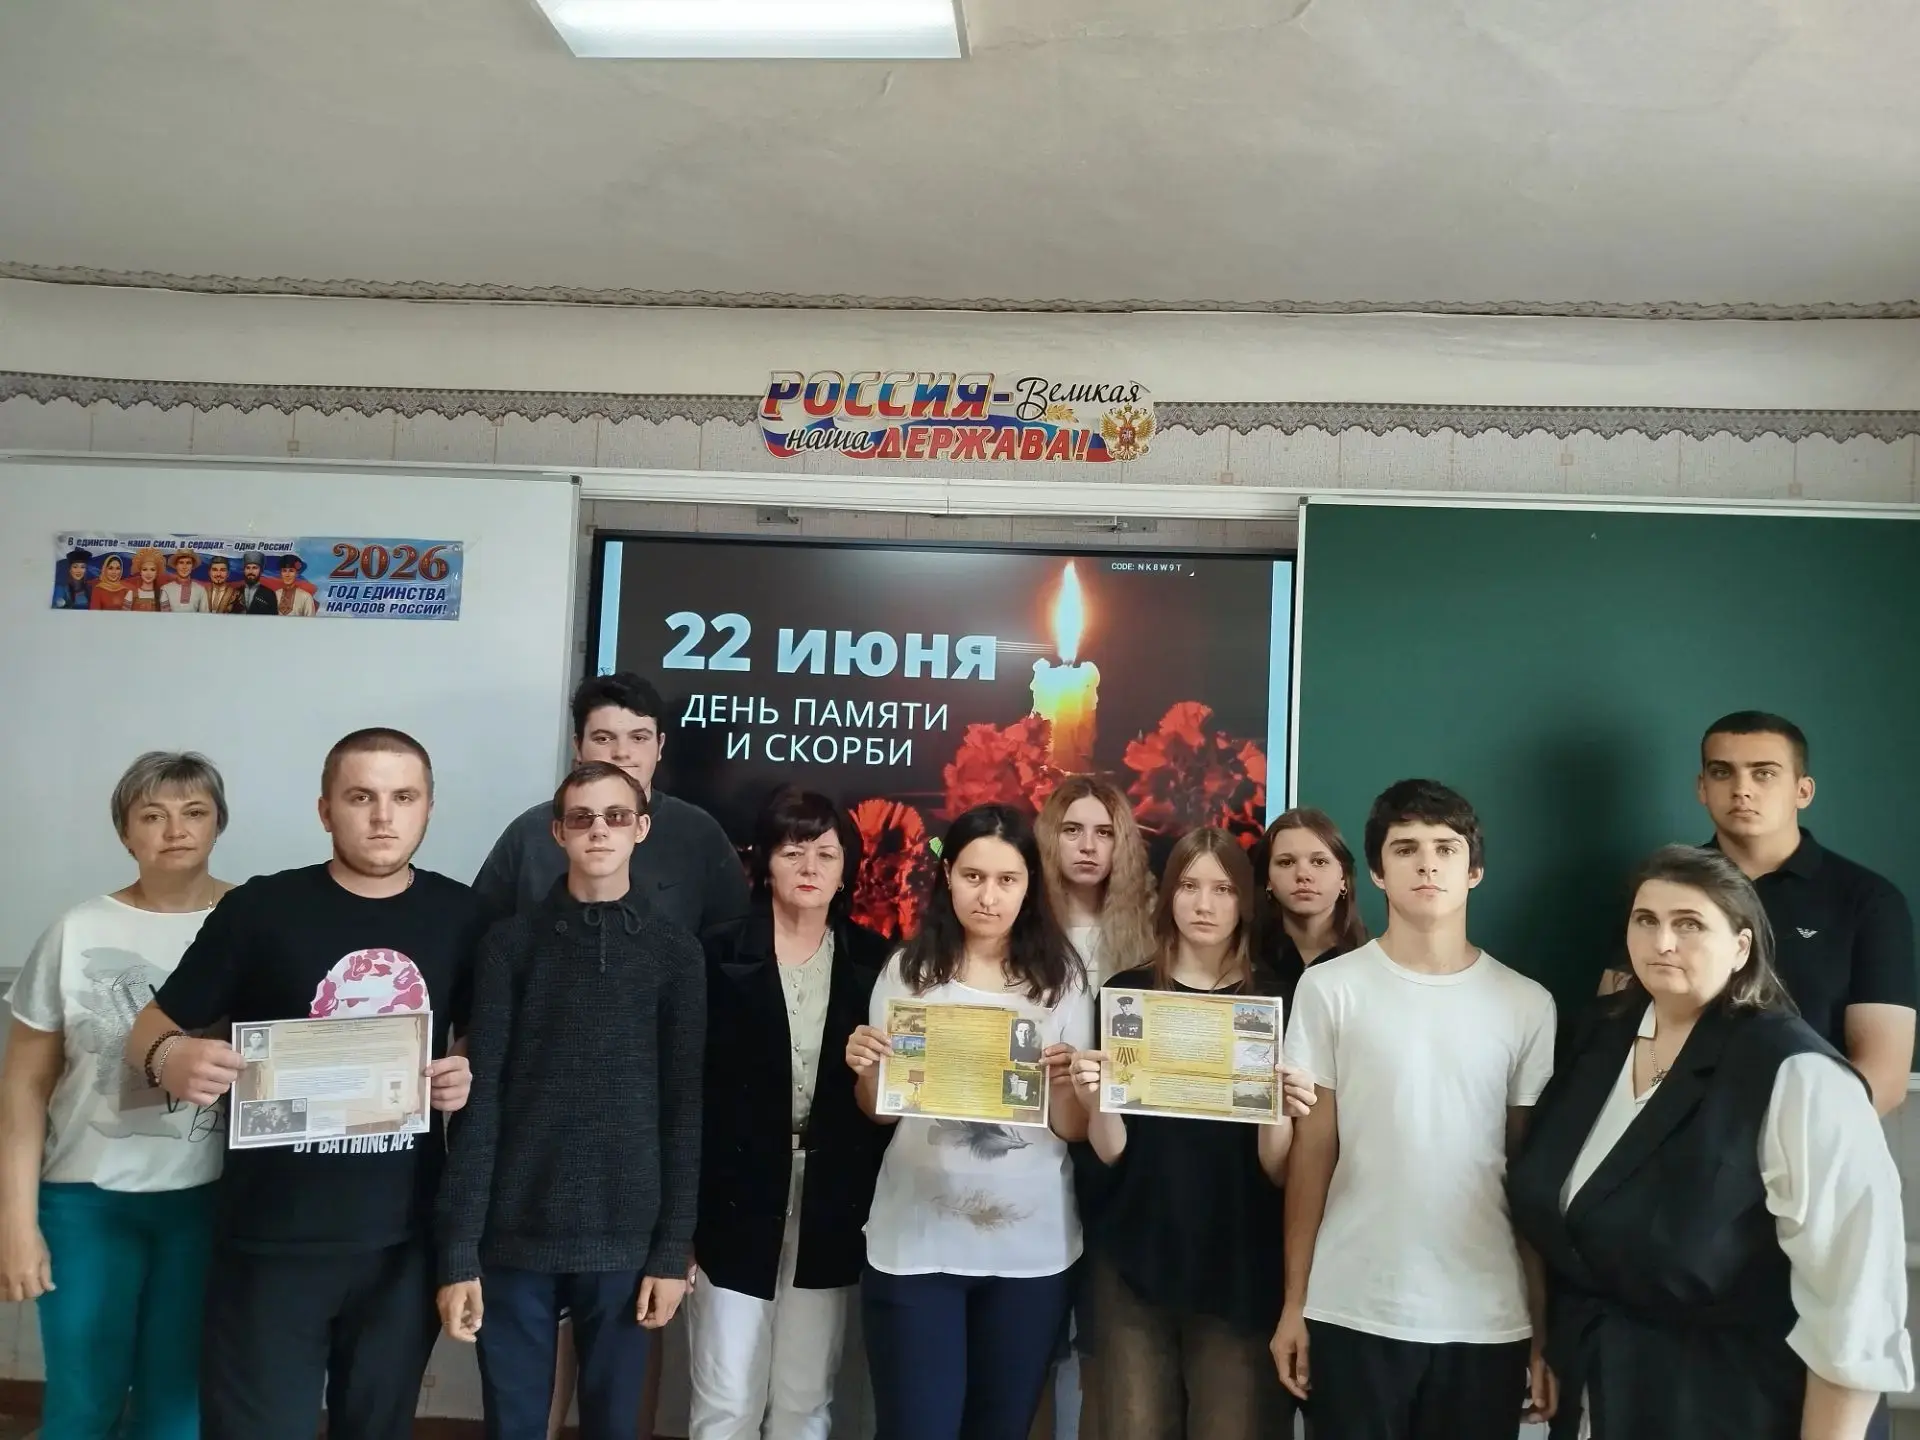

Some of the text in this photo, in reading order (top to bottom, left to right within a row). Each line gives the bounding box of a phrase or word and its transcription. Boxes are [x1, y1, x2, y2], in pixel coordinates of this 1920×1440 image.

[1016, 376, 1142, 421] Великая
[786, 426, 1091, 461] наша ДЕРЖАВА!
[76, 539, 119, 548] единстве
[127, 540, 151, 548] наша
[153, 540, 178, 549] сила,
[180, 541, 186, 549] в
[187, 541, 225, 550] сердцах
[234, 542, 256, 551] одна
[257, 542, 294, 551] Россия!
[329, 543, 450, 581] 2026
[1111, 562, 1135, 571] CODE:
[326, 601, 448, 615] НАРОДОВ РОССИИ!
[327, 585, 447, 601] ГОД ЕДИНСТВА
[662, 611, 997, 681] 22 июня
[680, 694, 949, 732] ДЕНЬ ПАМЯТИ
[726, 732, 913, 767] И СКОРБИ
[317, 1134, 389, 1154] BATHING
[389, 1132, 415, 1152] APE
